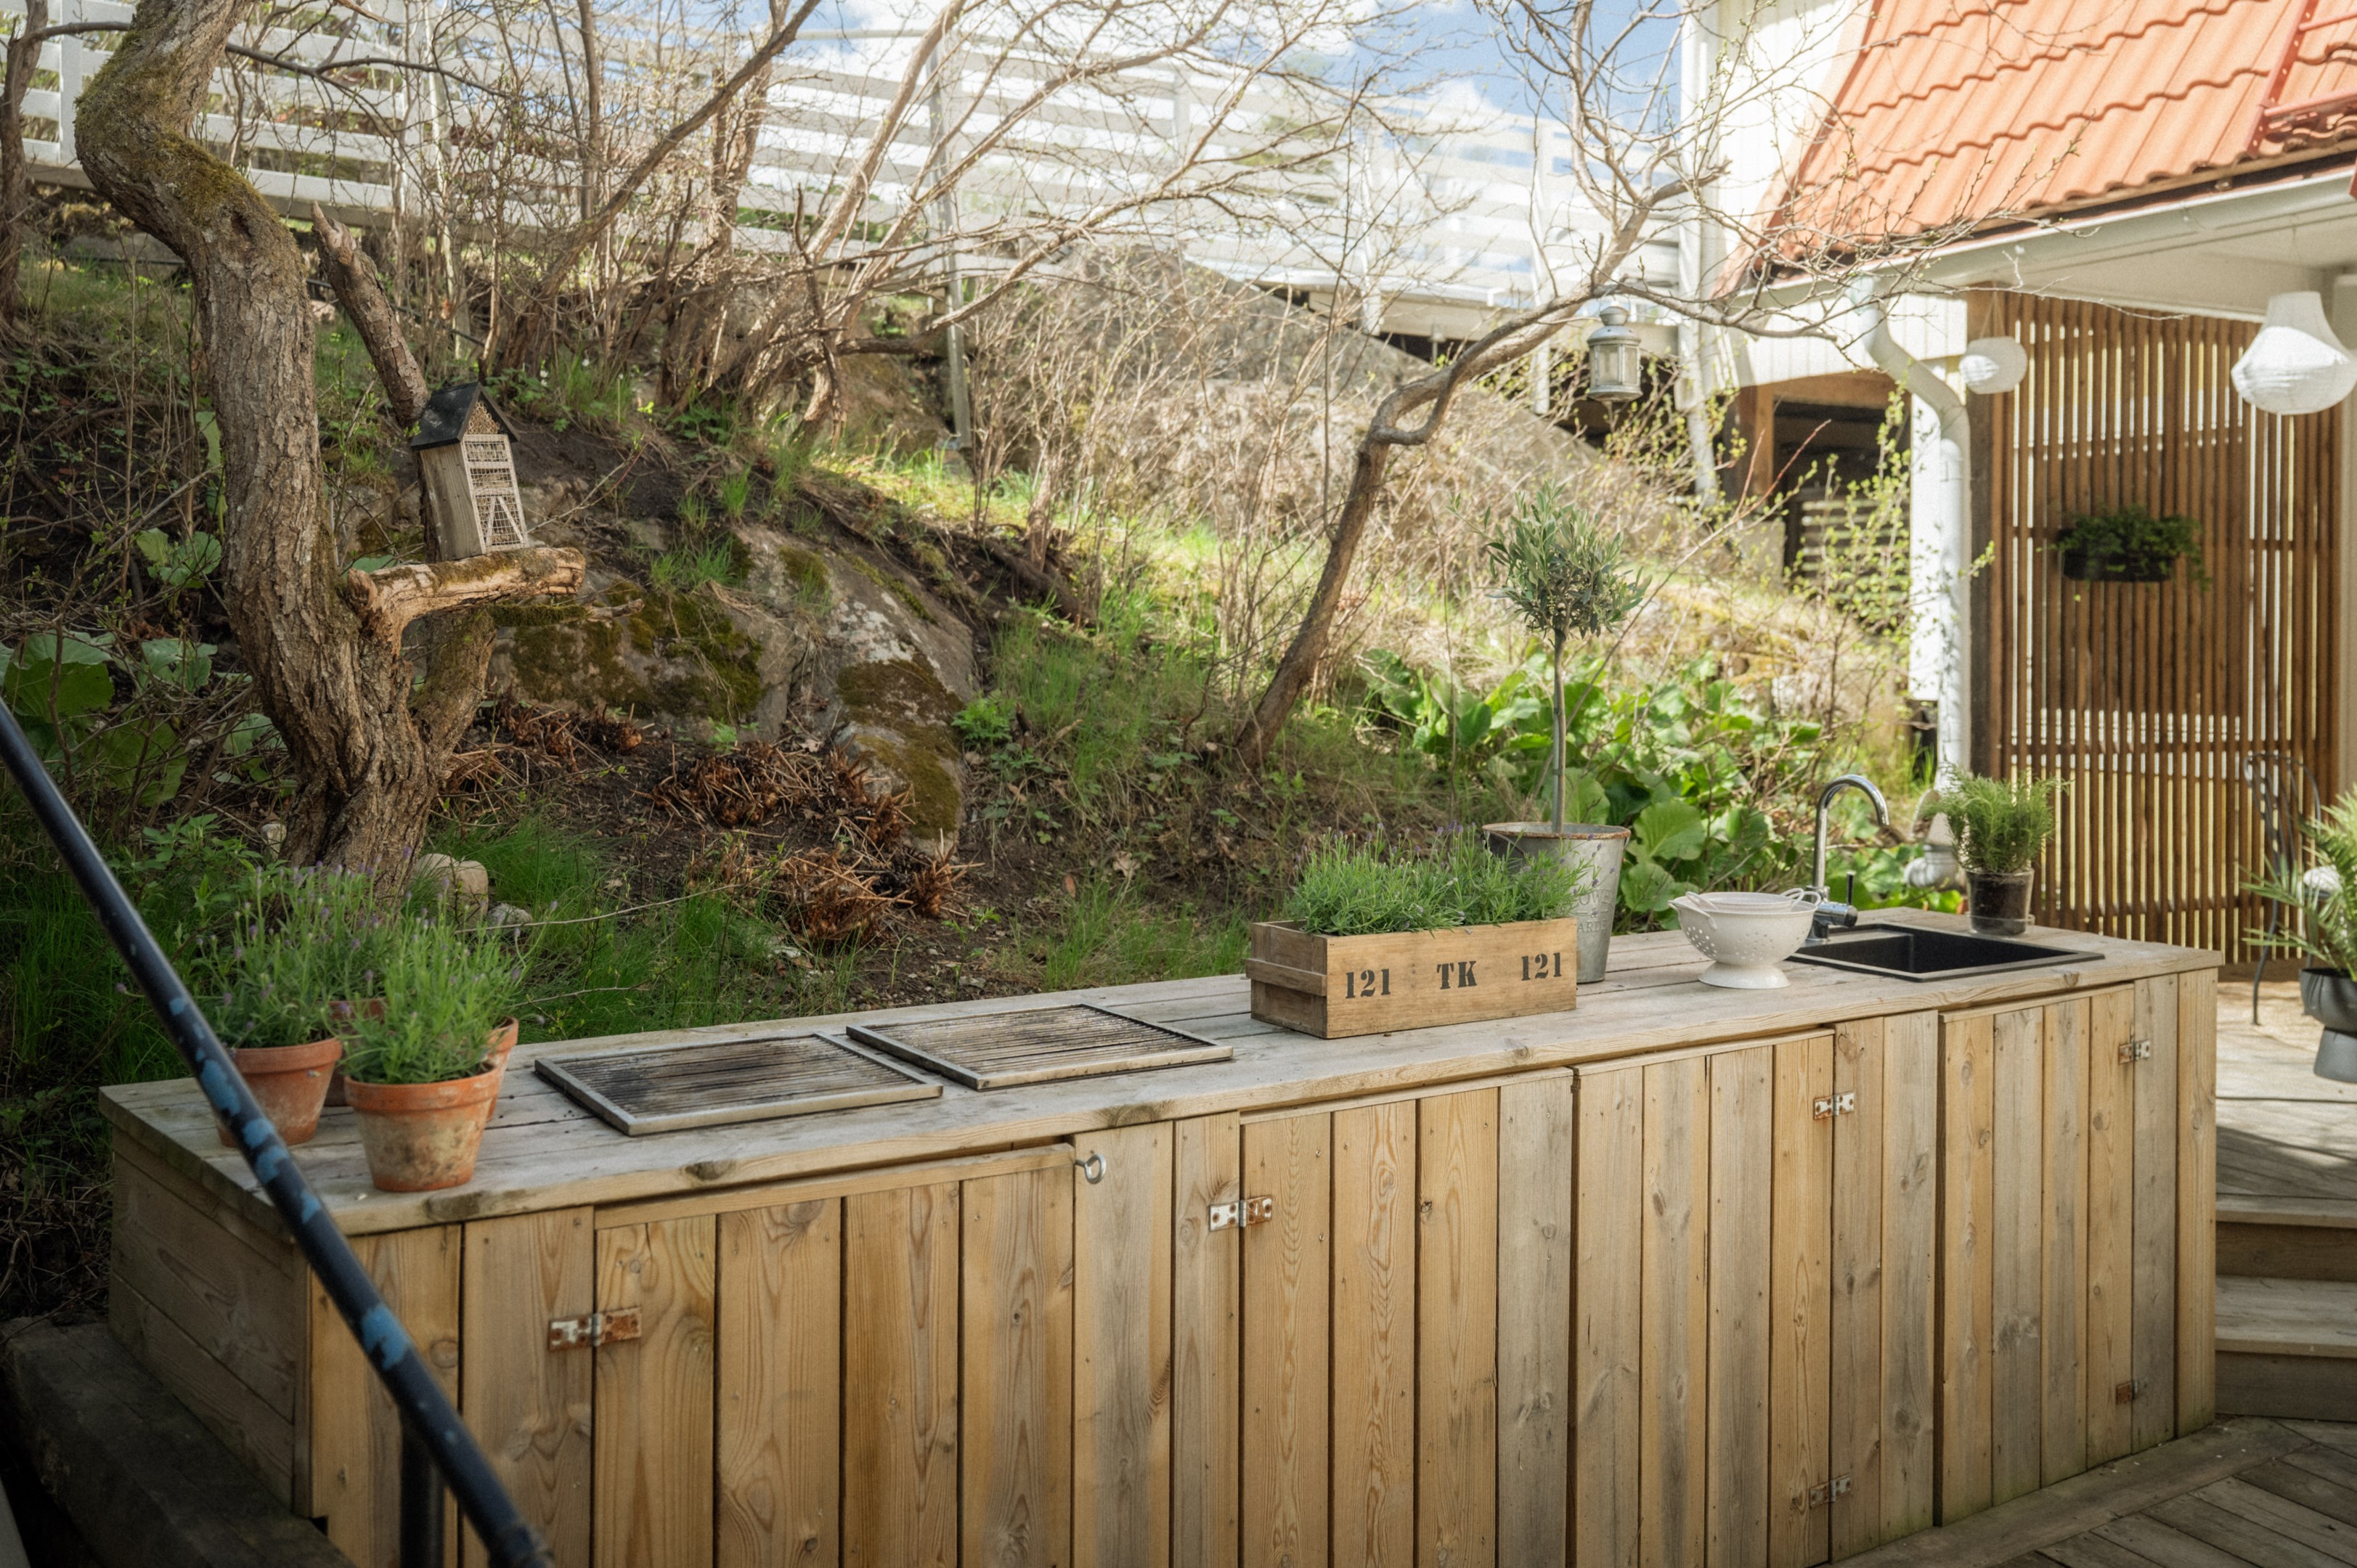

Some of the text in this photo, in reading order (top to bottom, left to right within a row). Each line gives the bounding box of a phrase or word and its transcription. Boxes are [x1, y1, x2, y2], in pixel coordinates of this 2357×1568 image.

[1577, 919, 1609, 933] ARDE
[1346, 952, 1562, 999] 121 TK 121
